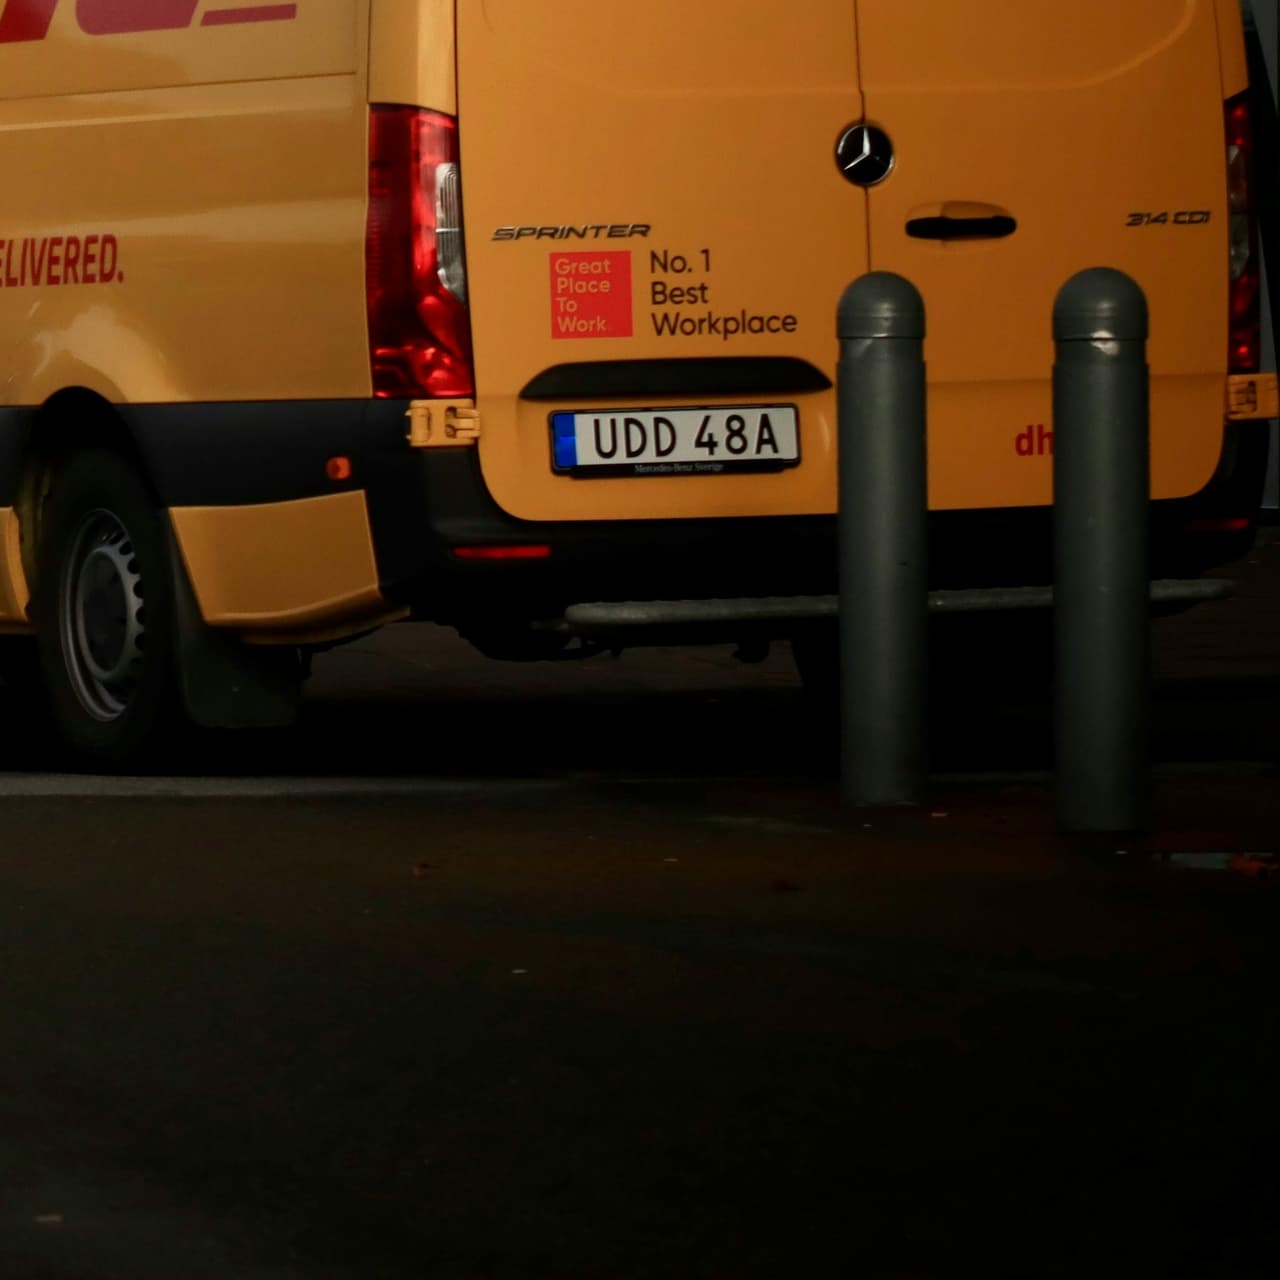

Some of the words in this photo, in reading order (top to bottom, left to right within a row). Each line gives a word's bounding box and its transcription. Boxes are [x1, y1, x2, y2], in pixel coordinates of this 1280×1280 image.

[1125, 211, 1168, 227] 314
[1173, 210, 1211, 224] CDI
[491, 223, 652, 241] SPRINTER
[554, 257, 612, 276] Great
[650, 250, 693, 274] No.
[700, 248, 711, 273] 1
[556, 277, 611, 294] Place
[650, 280, 709, 305] Best
[556, 296, 578, 313] To
[556, 315, 607, 333] Work
[651, 309, 798, 341] Workplace
[594, 416, 676, 459] UDD
[695, 413, 779, 455] 48A
[1015, 423, 1056, 457] dh
